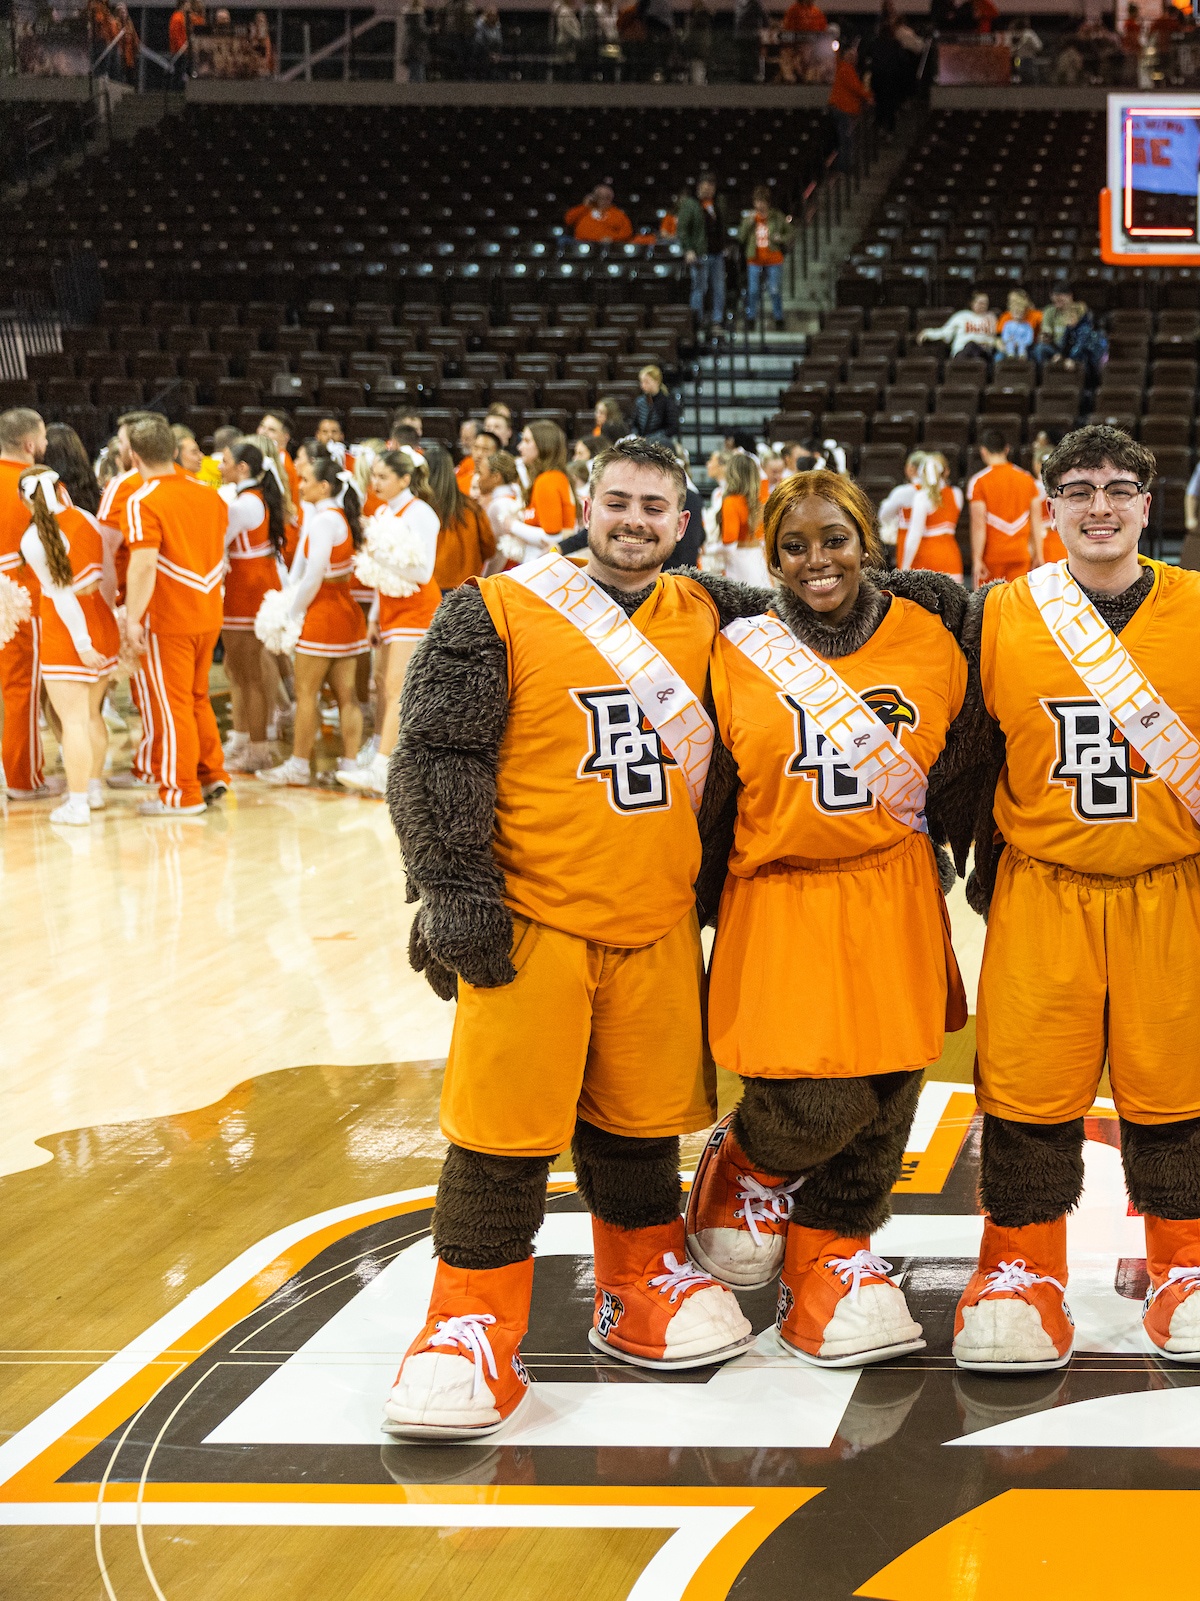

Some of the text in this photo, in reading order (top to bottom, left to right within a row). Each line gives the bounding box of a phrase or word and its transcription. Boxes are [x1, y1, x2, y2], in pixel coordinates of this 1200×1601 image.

[525, 558, 674, 705] FREDDIE
[656, 688, 675, 704] &
[737, 620, 875, 752] FREDDIE
[854, 734, 871, 748] &
[579, 690, 674, 811] BG
[1048, 702, 1133, 818] BG
[1141, 711, 1160, 728] &
